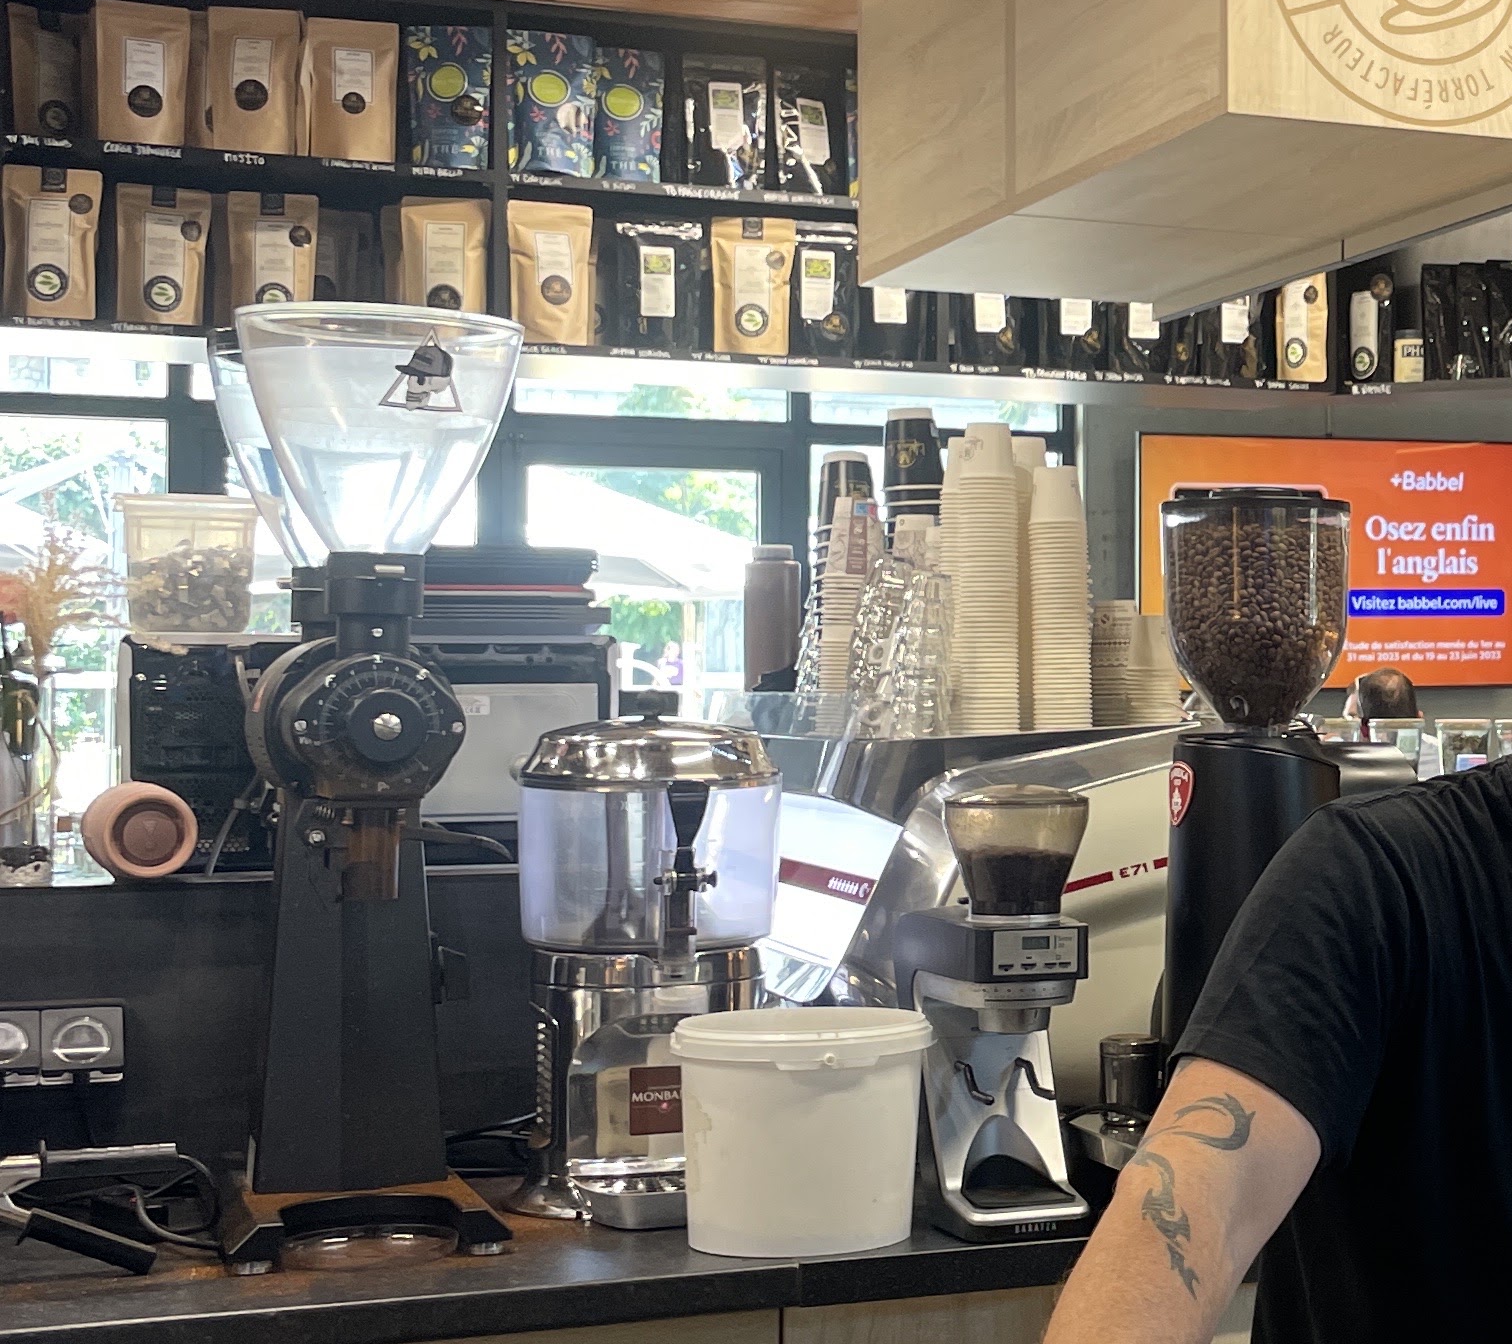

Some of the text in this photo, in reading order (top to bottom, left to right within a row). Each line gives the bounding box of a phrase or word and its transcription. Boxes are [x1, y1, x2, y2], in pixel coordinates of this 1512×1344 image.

[1323, 23, 1494, 110] TORRÉFACTEUR
[1365, 514, 1496, 542] Osez enfin
[1377, 547, 1479, 583] l'anglais
[1351, 594, 1499, 612] Visitez babbel.com/live
[1119, 862, 1149, 879] E71
